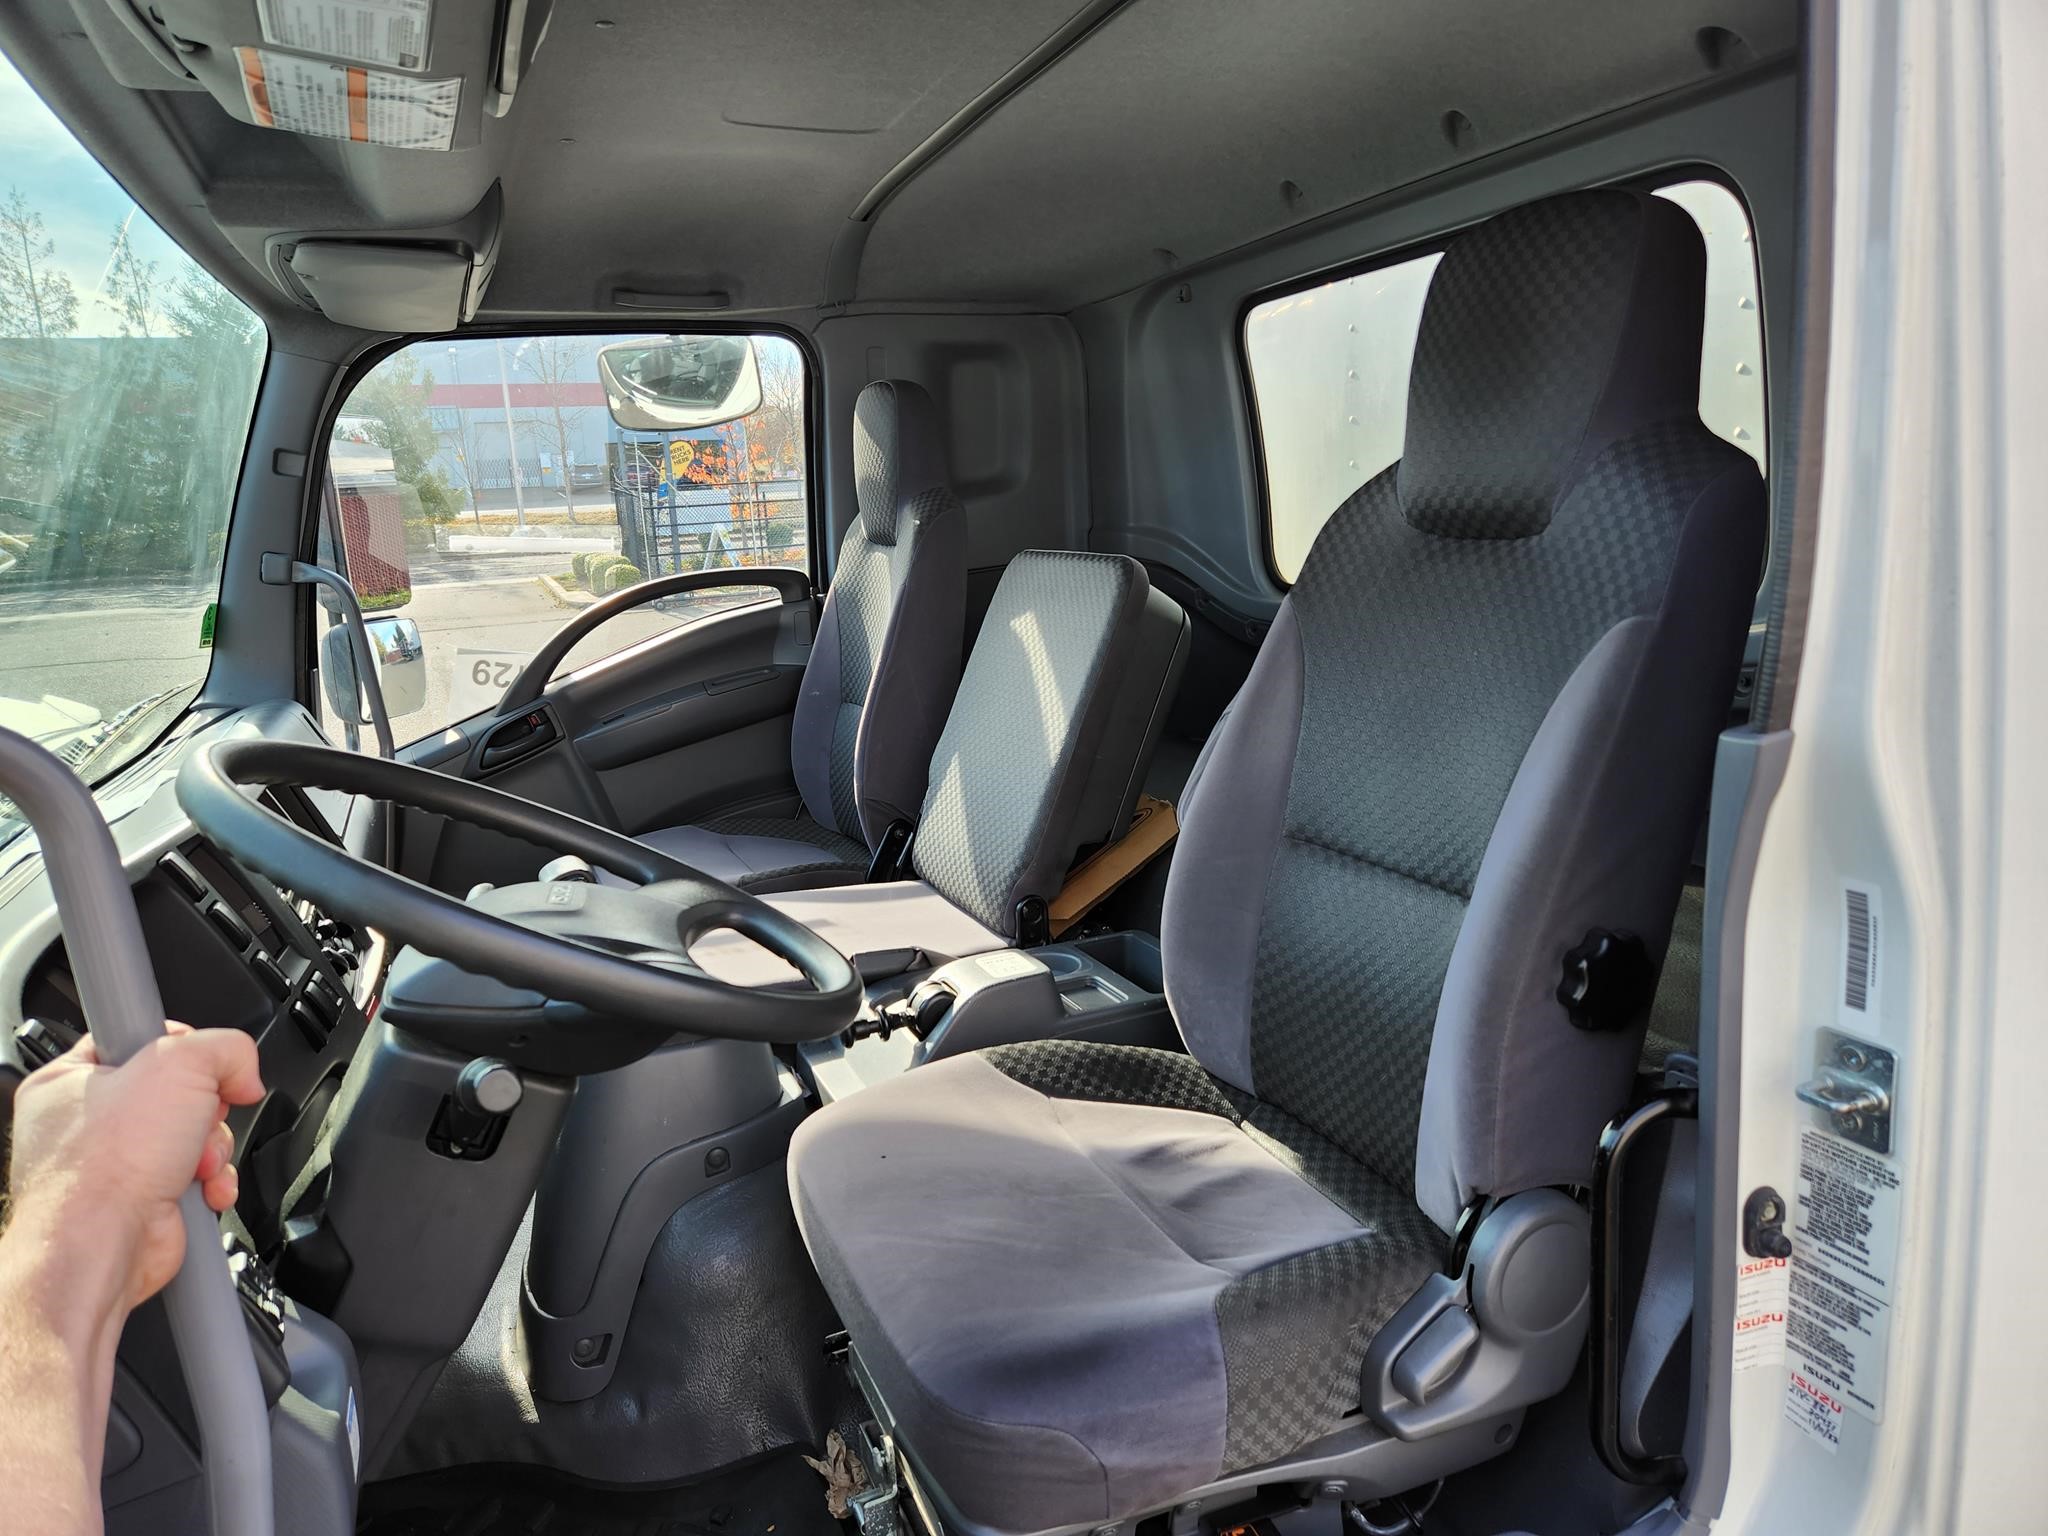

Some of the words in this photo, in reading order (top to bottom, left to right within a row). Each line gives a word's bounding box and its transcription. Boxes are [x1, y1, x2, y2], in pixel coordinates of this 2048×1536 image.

[670, 449, 692, 459] RUCKS
[673, 456, 690, 465] HERE
[1740, 1257, 1786, 1276] ISUZU
[1736, 1313, 1783, 1331] ISUZU
[1803, 1363, 1840, 1391] ISUZU
[1791, 1371, 1842, 1414] ISUZU
